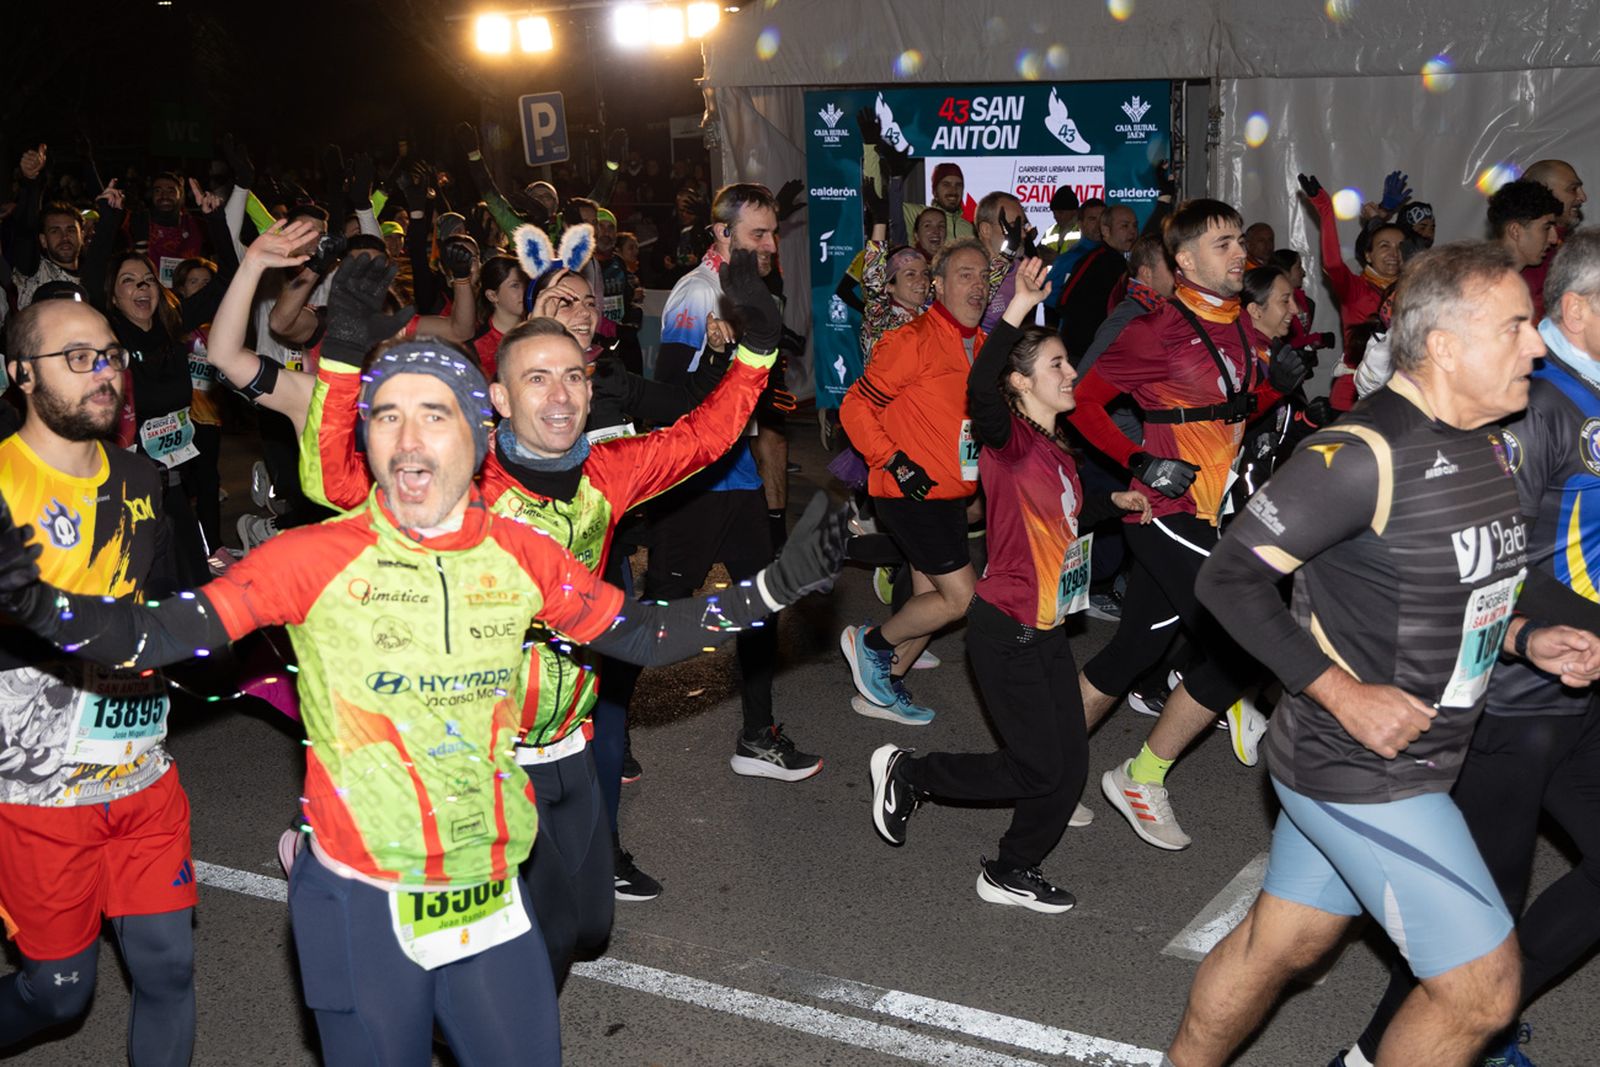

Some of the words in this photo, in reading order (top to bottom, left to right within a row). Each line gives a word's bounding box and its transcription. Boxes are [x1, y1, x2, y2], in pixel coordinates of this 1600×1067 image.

[938, 97, 970, 123] 43
[970, 96, 1025, 121] SAN
[531, 102, 557, 156] P
[885, 127, 900, 145] 43
[931, 118, 1020, 150] ANTÓN
[1058, 124, 1076, 143] 43
[1017, 175, 1046, 183] NOCHE
[1047, 175, 1058, 183] DE
[158, 430, 182, 451] 758
[93, 695, 163, 728] 13895
